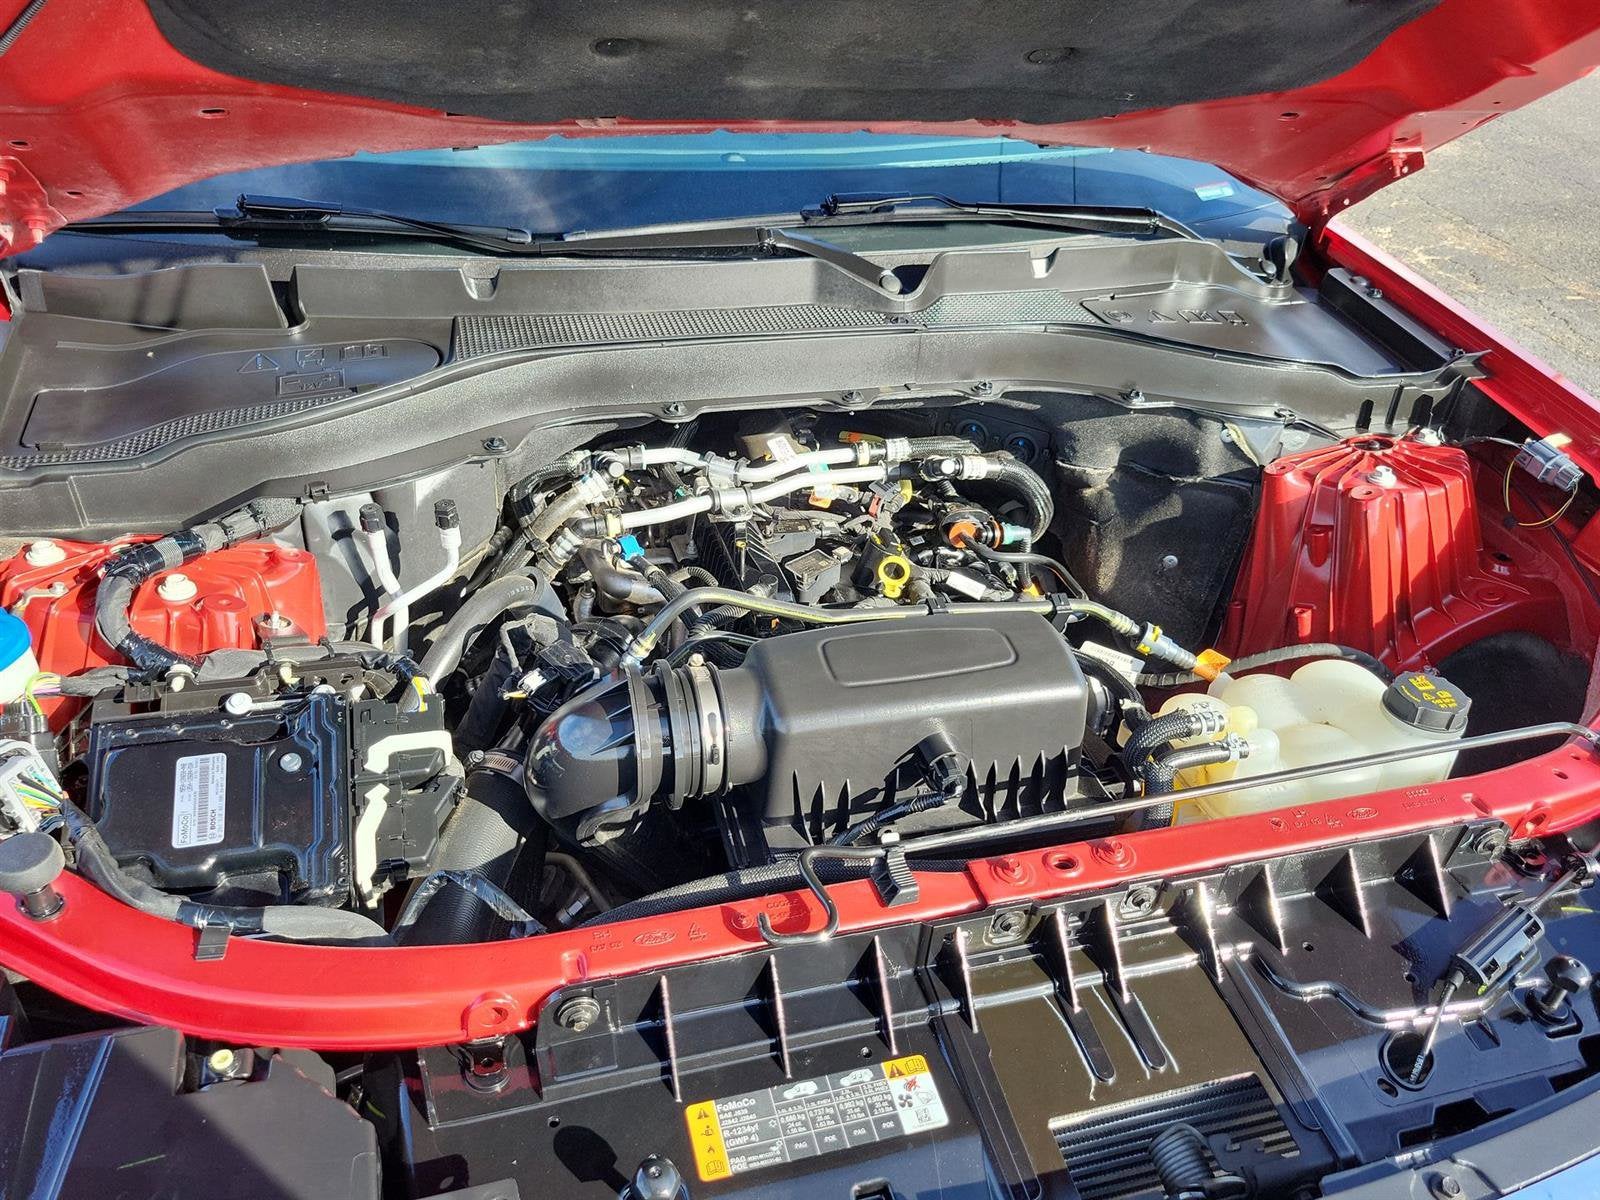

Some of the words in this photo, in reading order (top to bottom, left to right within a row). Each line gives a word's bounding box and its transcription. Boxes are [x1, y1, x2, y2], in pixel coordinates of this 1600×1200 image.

[180, 815, 189, 843] FoMoCo
[717, 1098, 756, 1113] FoMoCo
[824, 1105, 834, 1114] kg
[796, 1112, 806, 1121] kg
[881, 1120, 894, 1129] POE
[723, 1122, 759, 1138] R-1234yf
[852, 1127, 866, 1135] PAG
[725, 1135, 749, 1148] (GWP
[748, 1132, 759, 1142] 4)
[823, 1134, 837, 1143] POE
[794, 1141, 807, 1150] PAG
[729, 1155, 746, 1164] PAG
[731, 1161, 748, 1172] POE
